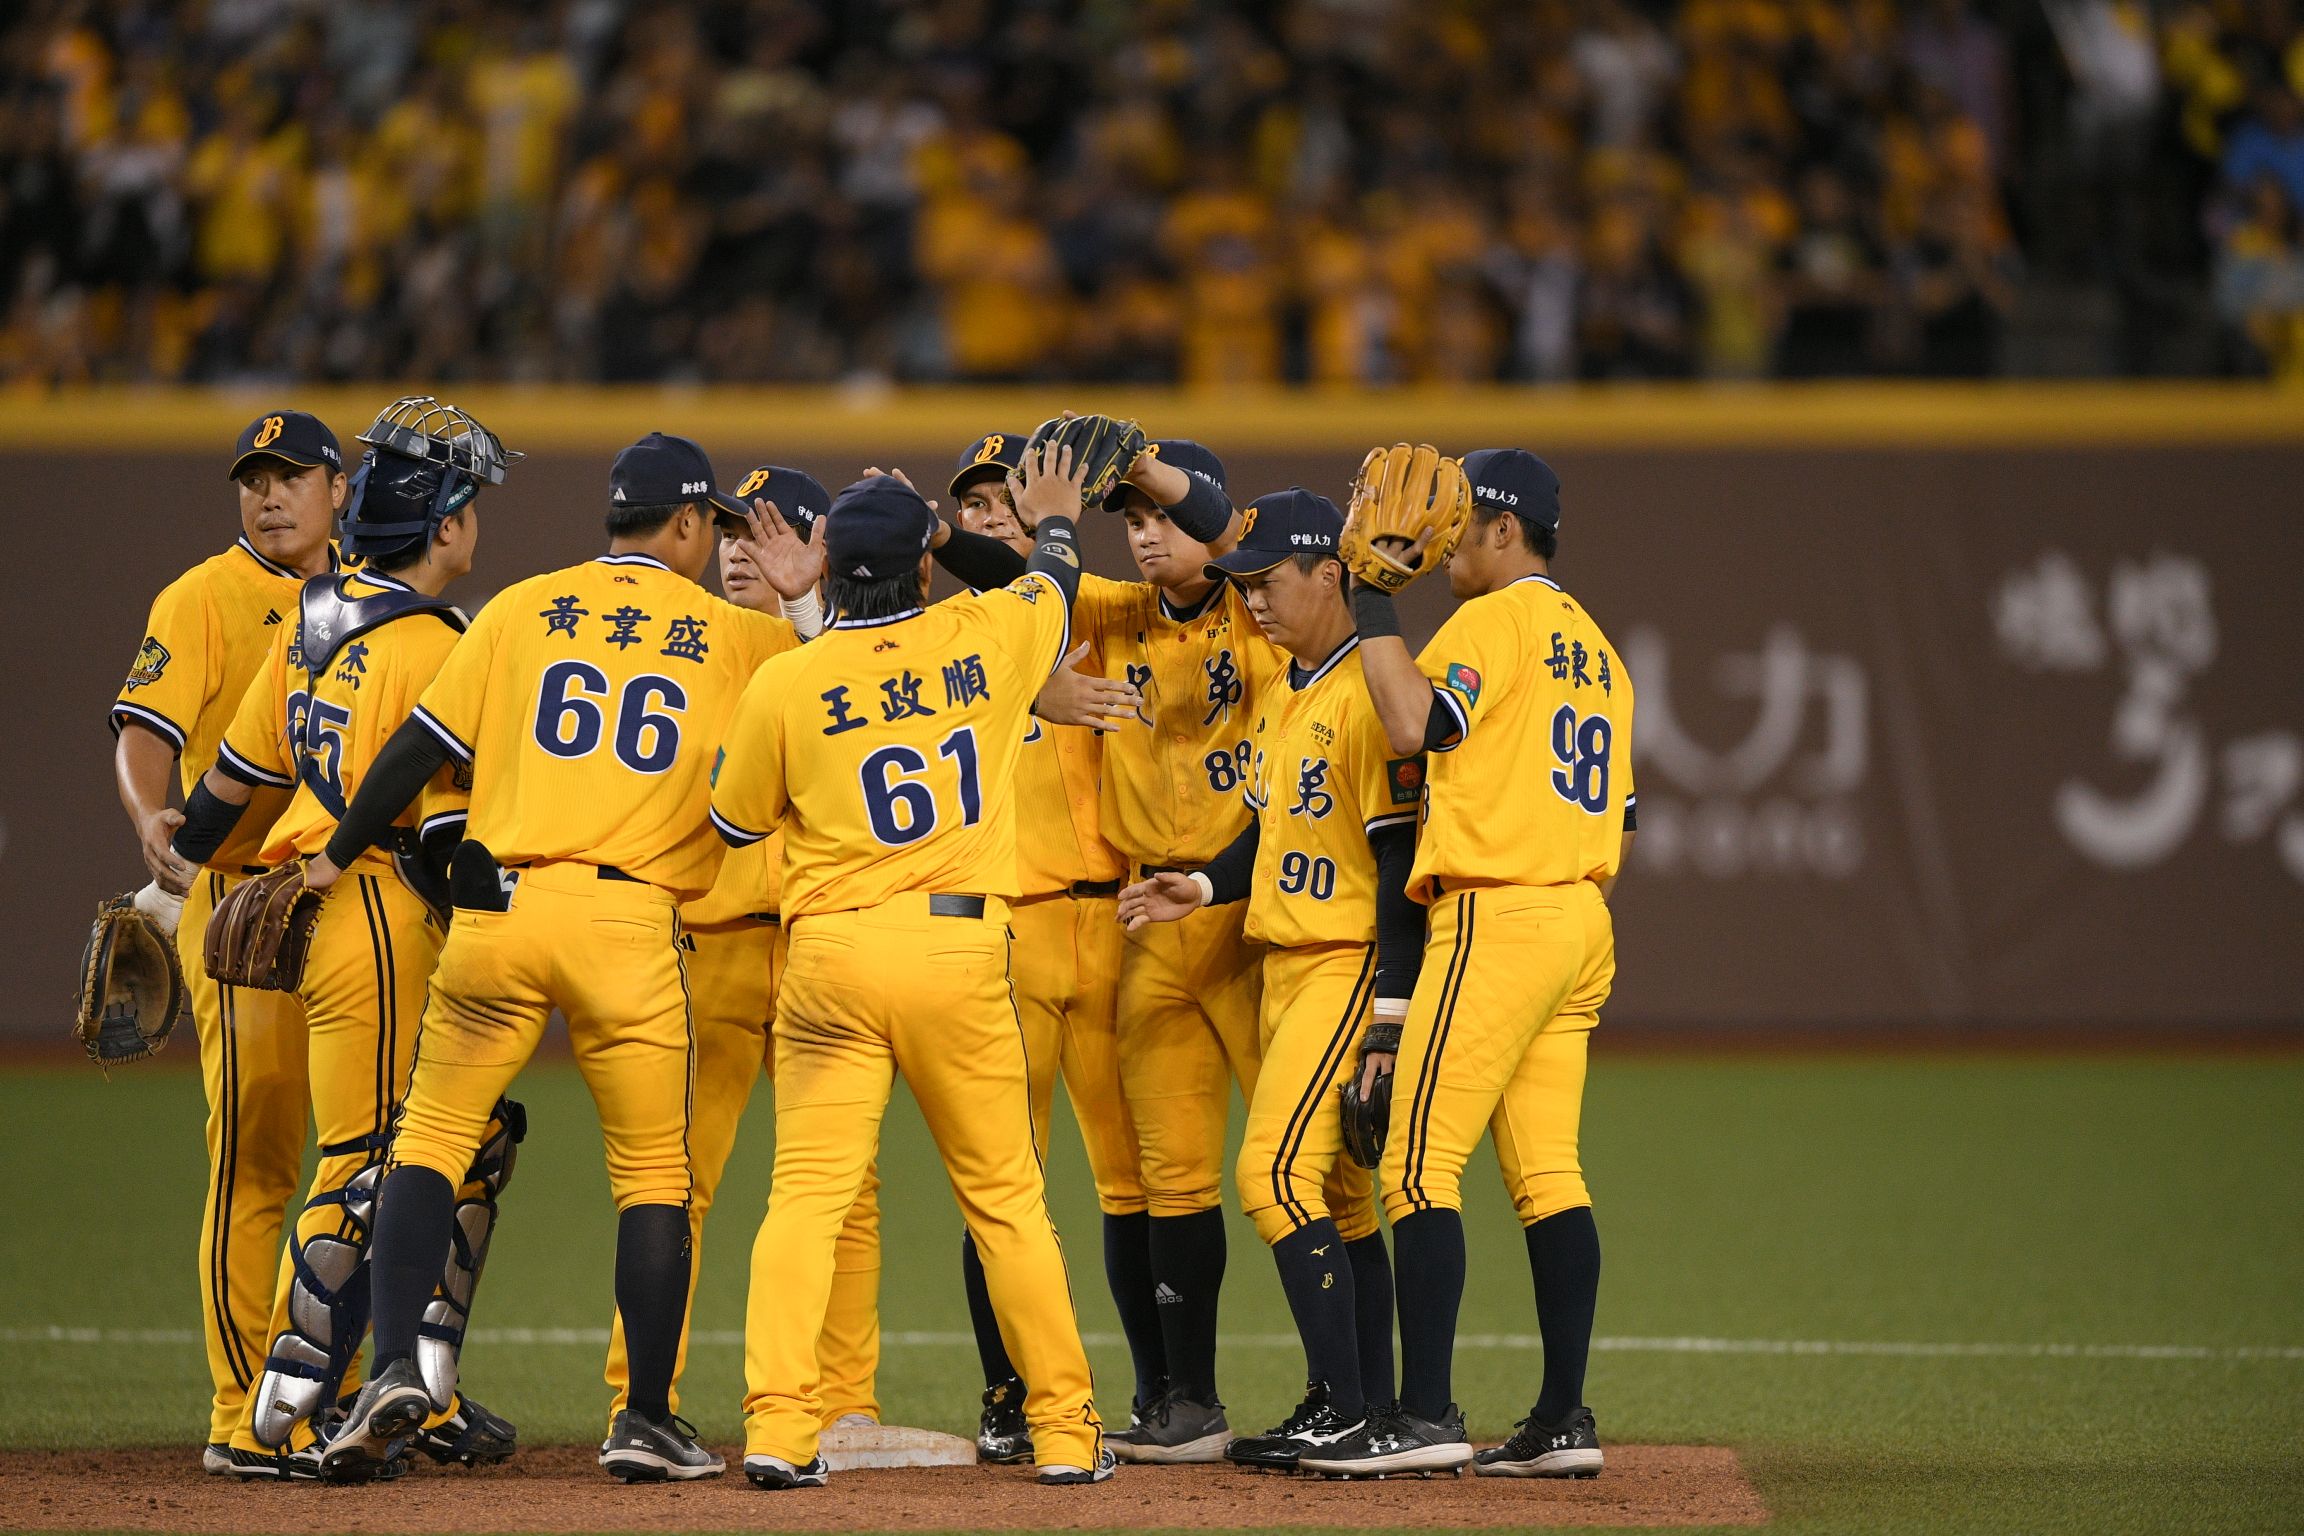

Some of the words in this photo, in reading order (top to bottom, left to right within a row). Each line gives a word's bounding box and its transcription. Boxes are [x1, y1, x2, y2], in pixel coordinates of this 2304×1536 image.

[798, 505, 816, 523] 守信
[1476, 485, 1519, 506] 守信人力
[1290, 533, 1331, 546] 守信人力
[539, 594, 709, 664] 黃韋盛
[532, 659, 689, 775] 66
[820, 653, 990, 737] 王政順
[858, 726, 982, 847] 61
[1203, 739, 1251, 793] 88
[1550, 701, 1612, 816] 98
[1278, 850, 1336, 901] 90
